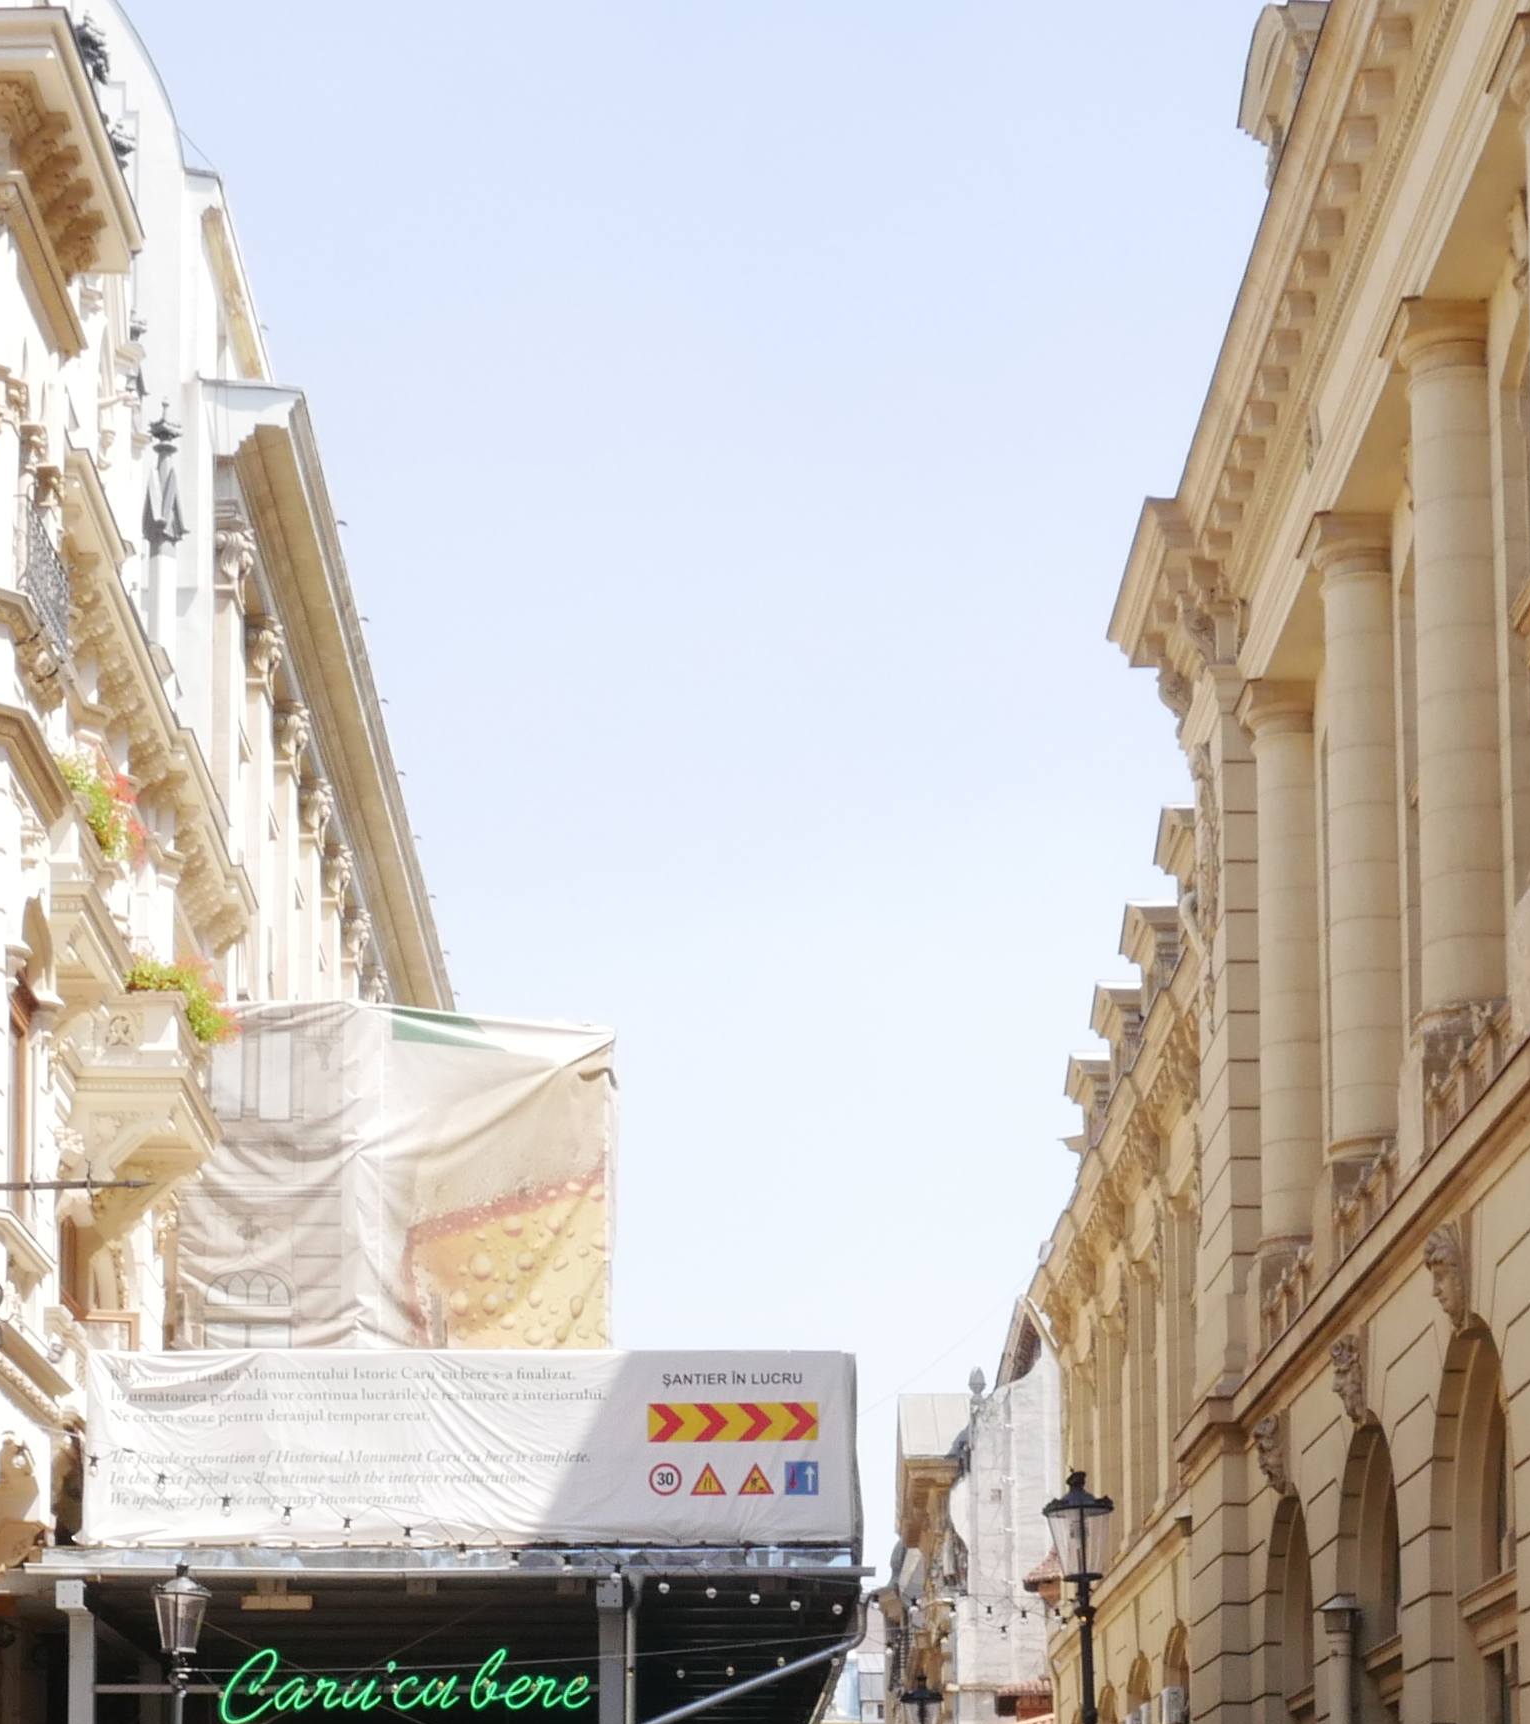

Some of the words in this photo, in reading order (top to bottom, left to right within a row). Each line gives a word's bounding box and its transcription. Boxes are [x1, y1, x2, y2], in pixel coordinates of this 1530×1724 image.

[245, 1366, 349, 1381] Monumentului
[352, 1366, 398, 1380] Istoric
[440, 1369, 458, 1380] cu
[460, 1366, 490, 1380] bere
[492, 1369, 514, 1380] s-a
[516, 1366, 577, 1381] finalizat.
[731, 1370, 747, 1385] ÎN
[750, 1372, 803, 1385] LUCRU
[210, 1388, 268, 1406] perioadă
[272, 1392, 293, 1401] vor
[295, 1389, 358, 1402] continua
[361, 1387, 419, 1401] lucrările
[421, 1387, 439, 1401] de
[441, 1390, 509, 1402] restaurare
[511, 1392, 520, 1401] a
[522, 1387, 608, 1402] interiorului.
[110, 1409, 130, 1423] Ne
[132, 1413, 174, 1424] cerem
[176, 1413, 216, 1424] scuze
[218, 1410, 263, 1427] pentru
[266, 1408, 324, 1425] deranjul
[327, 1410, 391, 1426] temporar
[392, 1410, 431, 1422] creat.
[111, 1449, 135, 1464] The
[183, 1451, 256, 1464] restoration
[258, 1449, 274, 1468] of
[275, 1450, 342, 1464] Historical
[346, 1449, 422, 1464] Monument
[467, 1452, 481, 1463] cu
[484, 1449, 514, 1464] bere
[516, 1450, 527, 1463] is
[529, 1450, 592, 1469] complete.
[109, 1471, 126, 1485] In
[128, 1471, 151, 1485] the
[185, 1471, 229, 1489] period
[267, 1473, 326, 1485] continue
[327, 1471, 361, 1485] with
[363, 1470, 385, 1484] the
[388, 1470, 441, 1484] interior
[656, 1471, 675, 1487] 30
[109, 1491, 130, 1506] We
[131, 1492, 196, 1510] apologize
[196, 1491, 220, 1510] for
[220, 1491, 243, 1506] he
[391, 1674, 463, 1711] cu
[472, 1647, 592, 1711] bere
